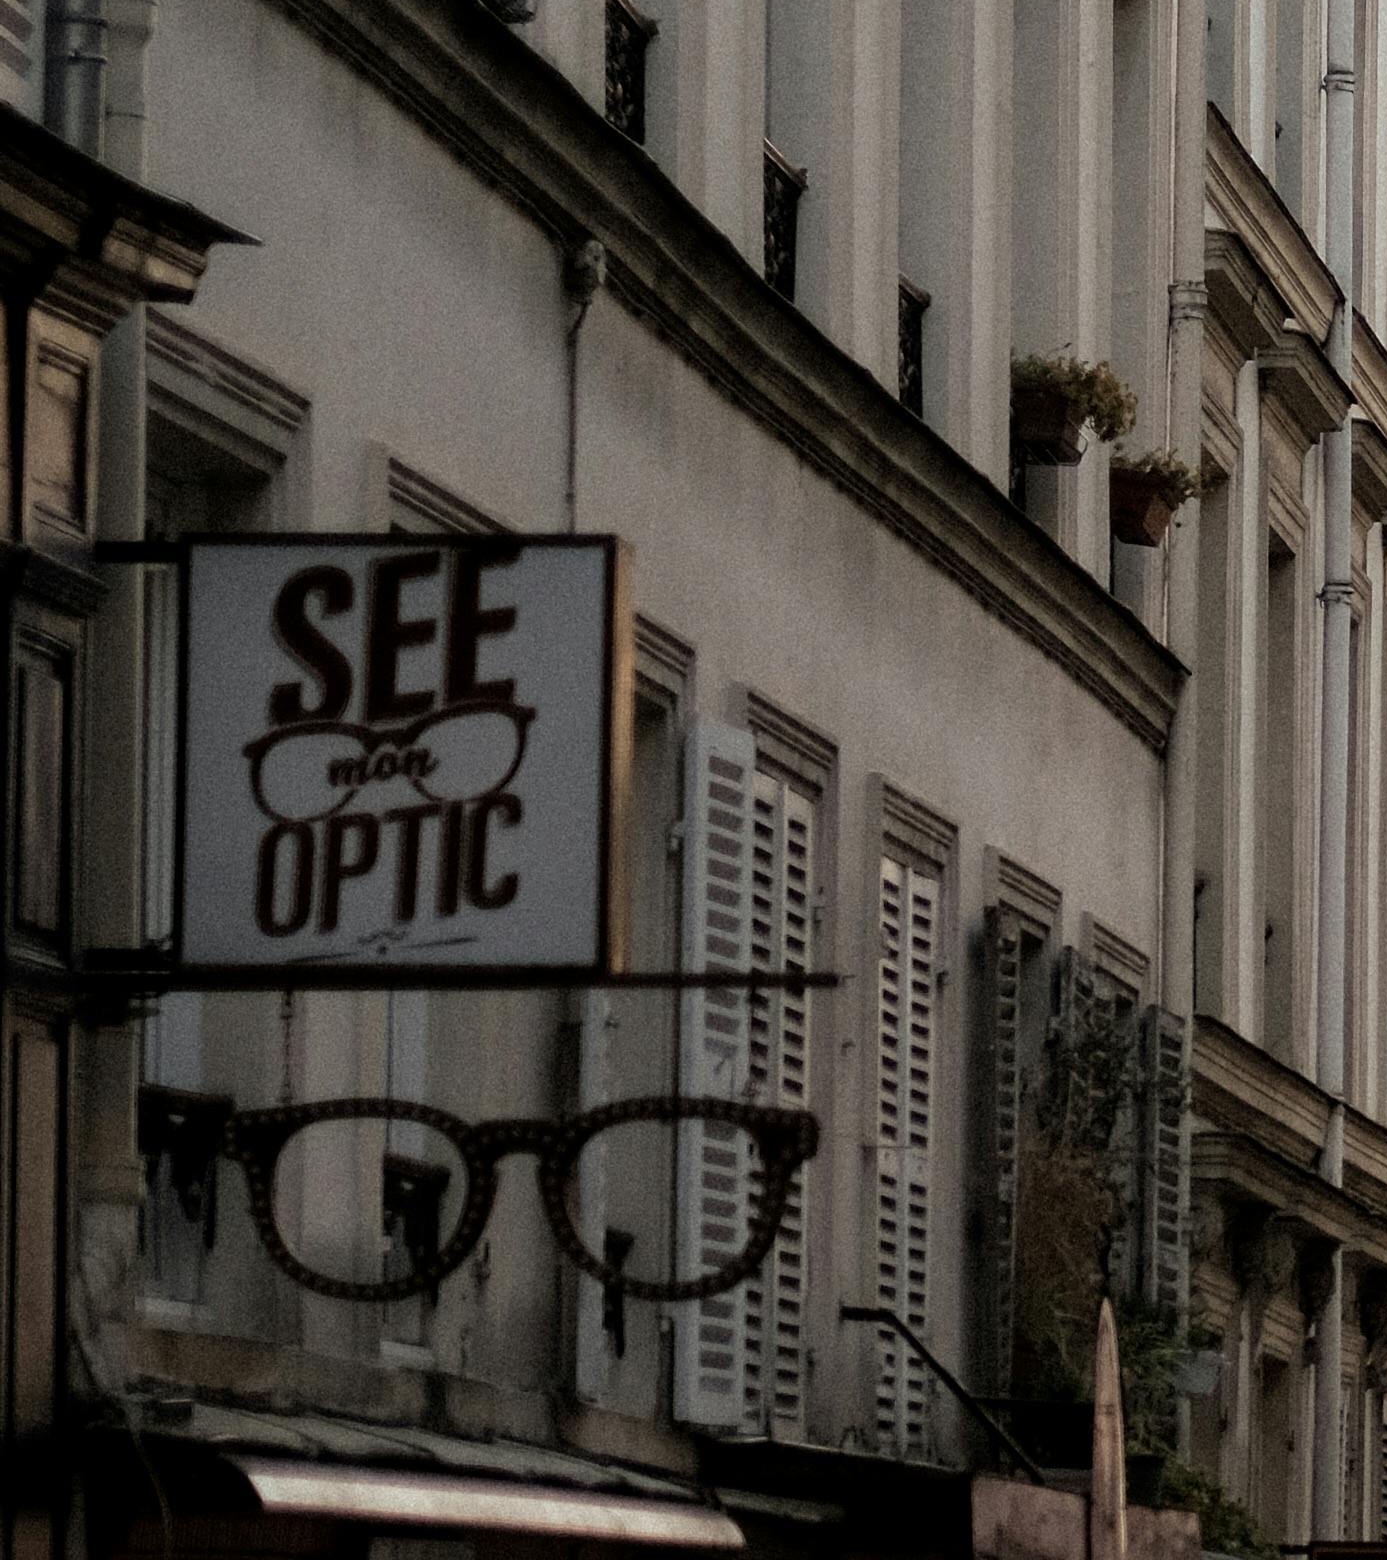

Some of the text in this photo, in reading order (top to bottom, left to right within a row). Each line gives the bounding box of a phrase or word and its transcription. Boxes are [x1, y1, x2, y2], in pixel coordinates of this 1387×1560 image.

[270, 544, 522, 725] SEE
[328, 750, 438, 787] mon
[256, 792, 522, 938] OPTIC
